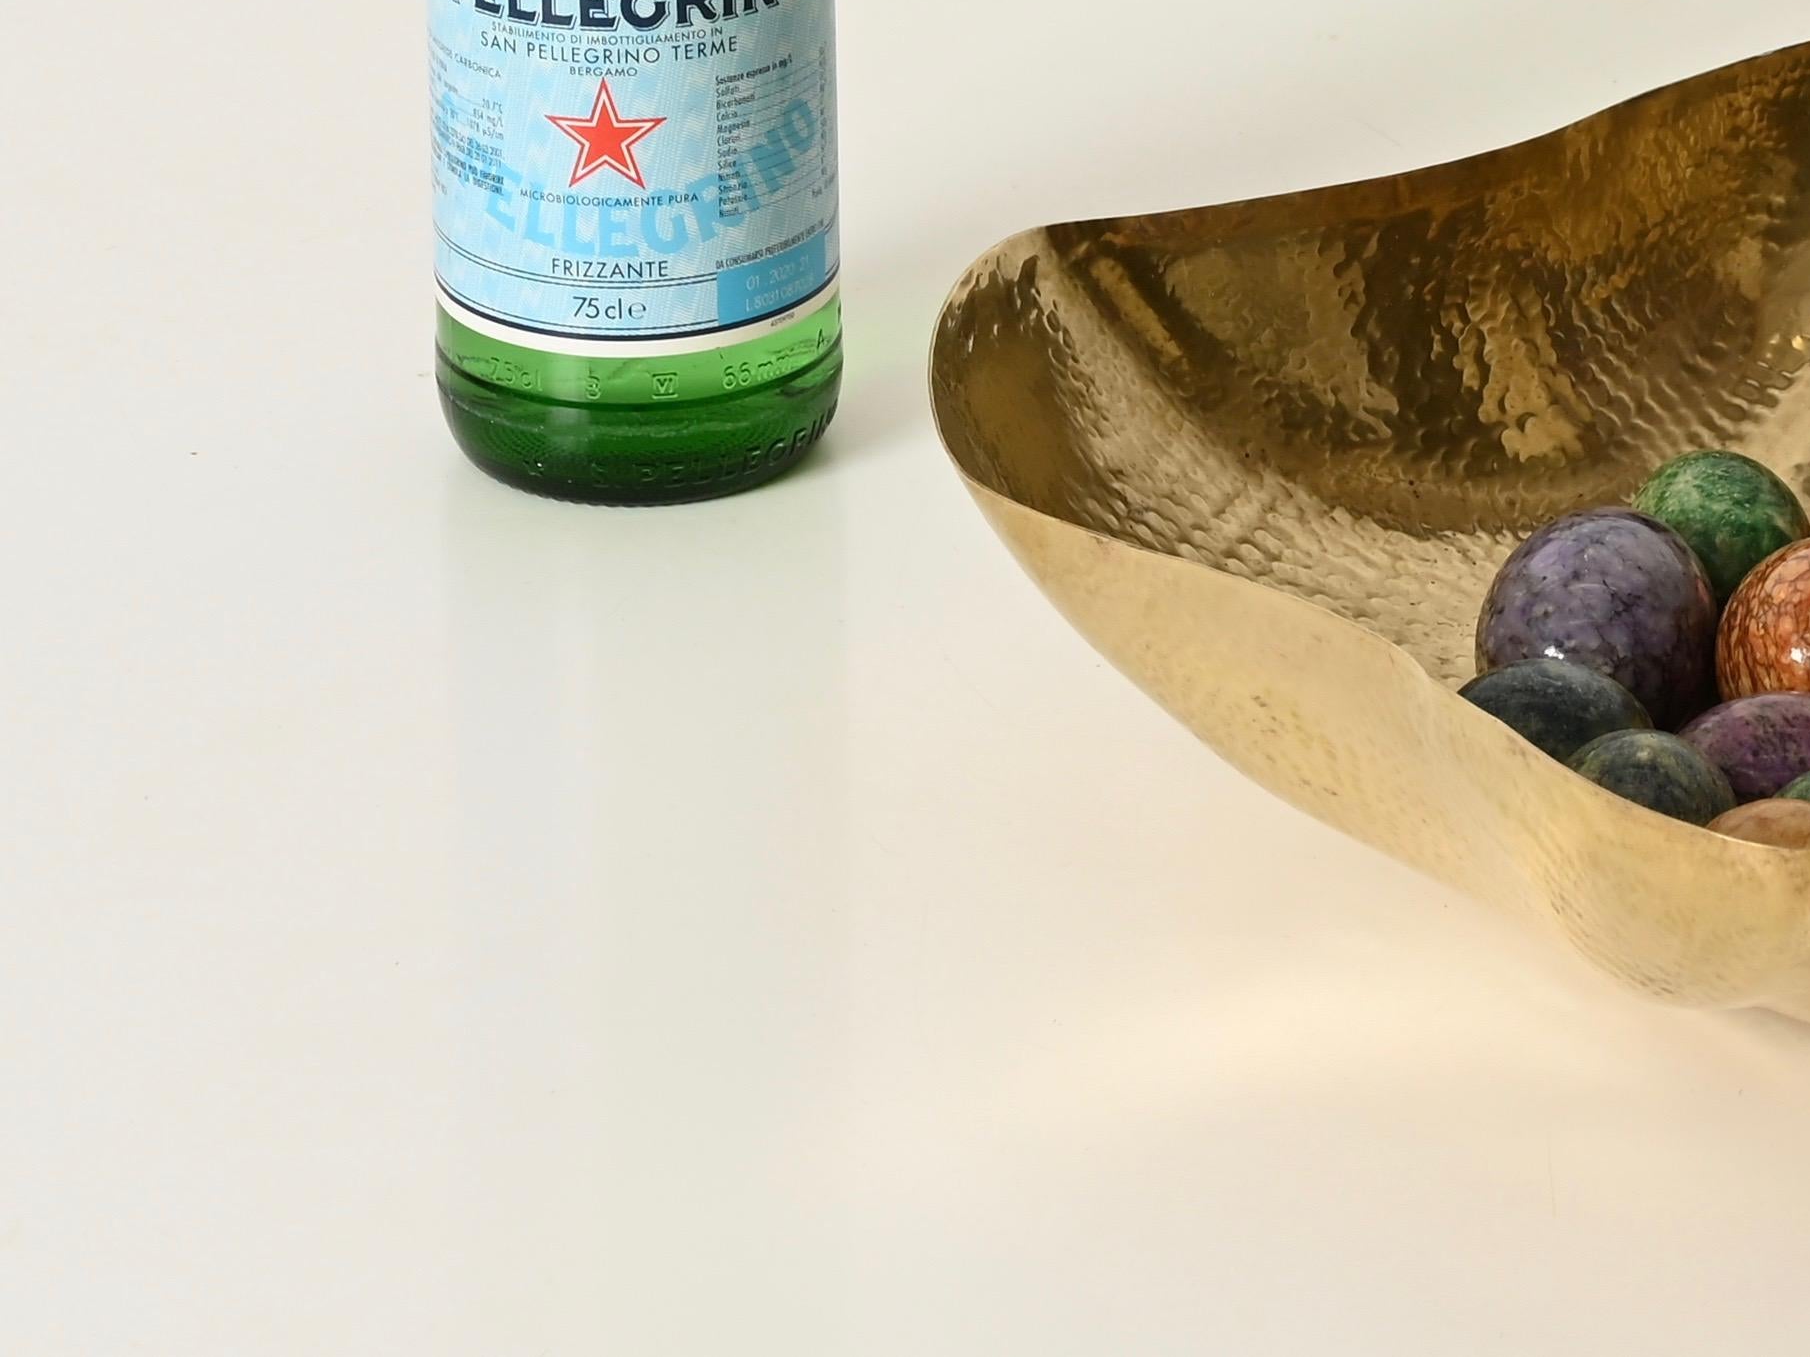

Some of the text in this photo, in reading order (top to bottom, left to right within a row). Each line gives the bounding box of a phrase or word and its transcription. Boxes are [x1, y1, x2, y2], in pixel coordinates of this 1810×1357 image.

[491, 21, 723, 45] STABILIMENTO DI IMBOTTIGLIAMENTO IN
[480, 30, 516, 54] SAN
[526, 41, 660, 65] PELLEGRINO
[671, 36, 738, 61] TERME
[569, 66, 638, 78] BERGAMO
[520, 189, 699, 207] MICROBIOLOGICAMENTE PURA
[551, 258, 669, 279] FRIZZANTE
